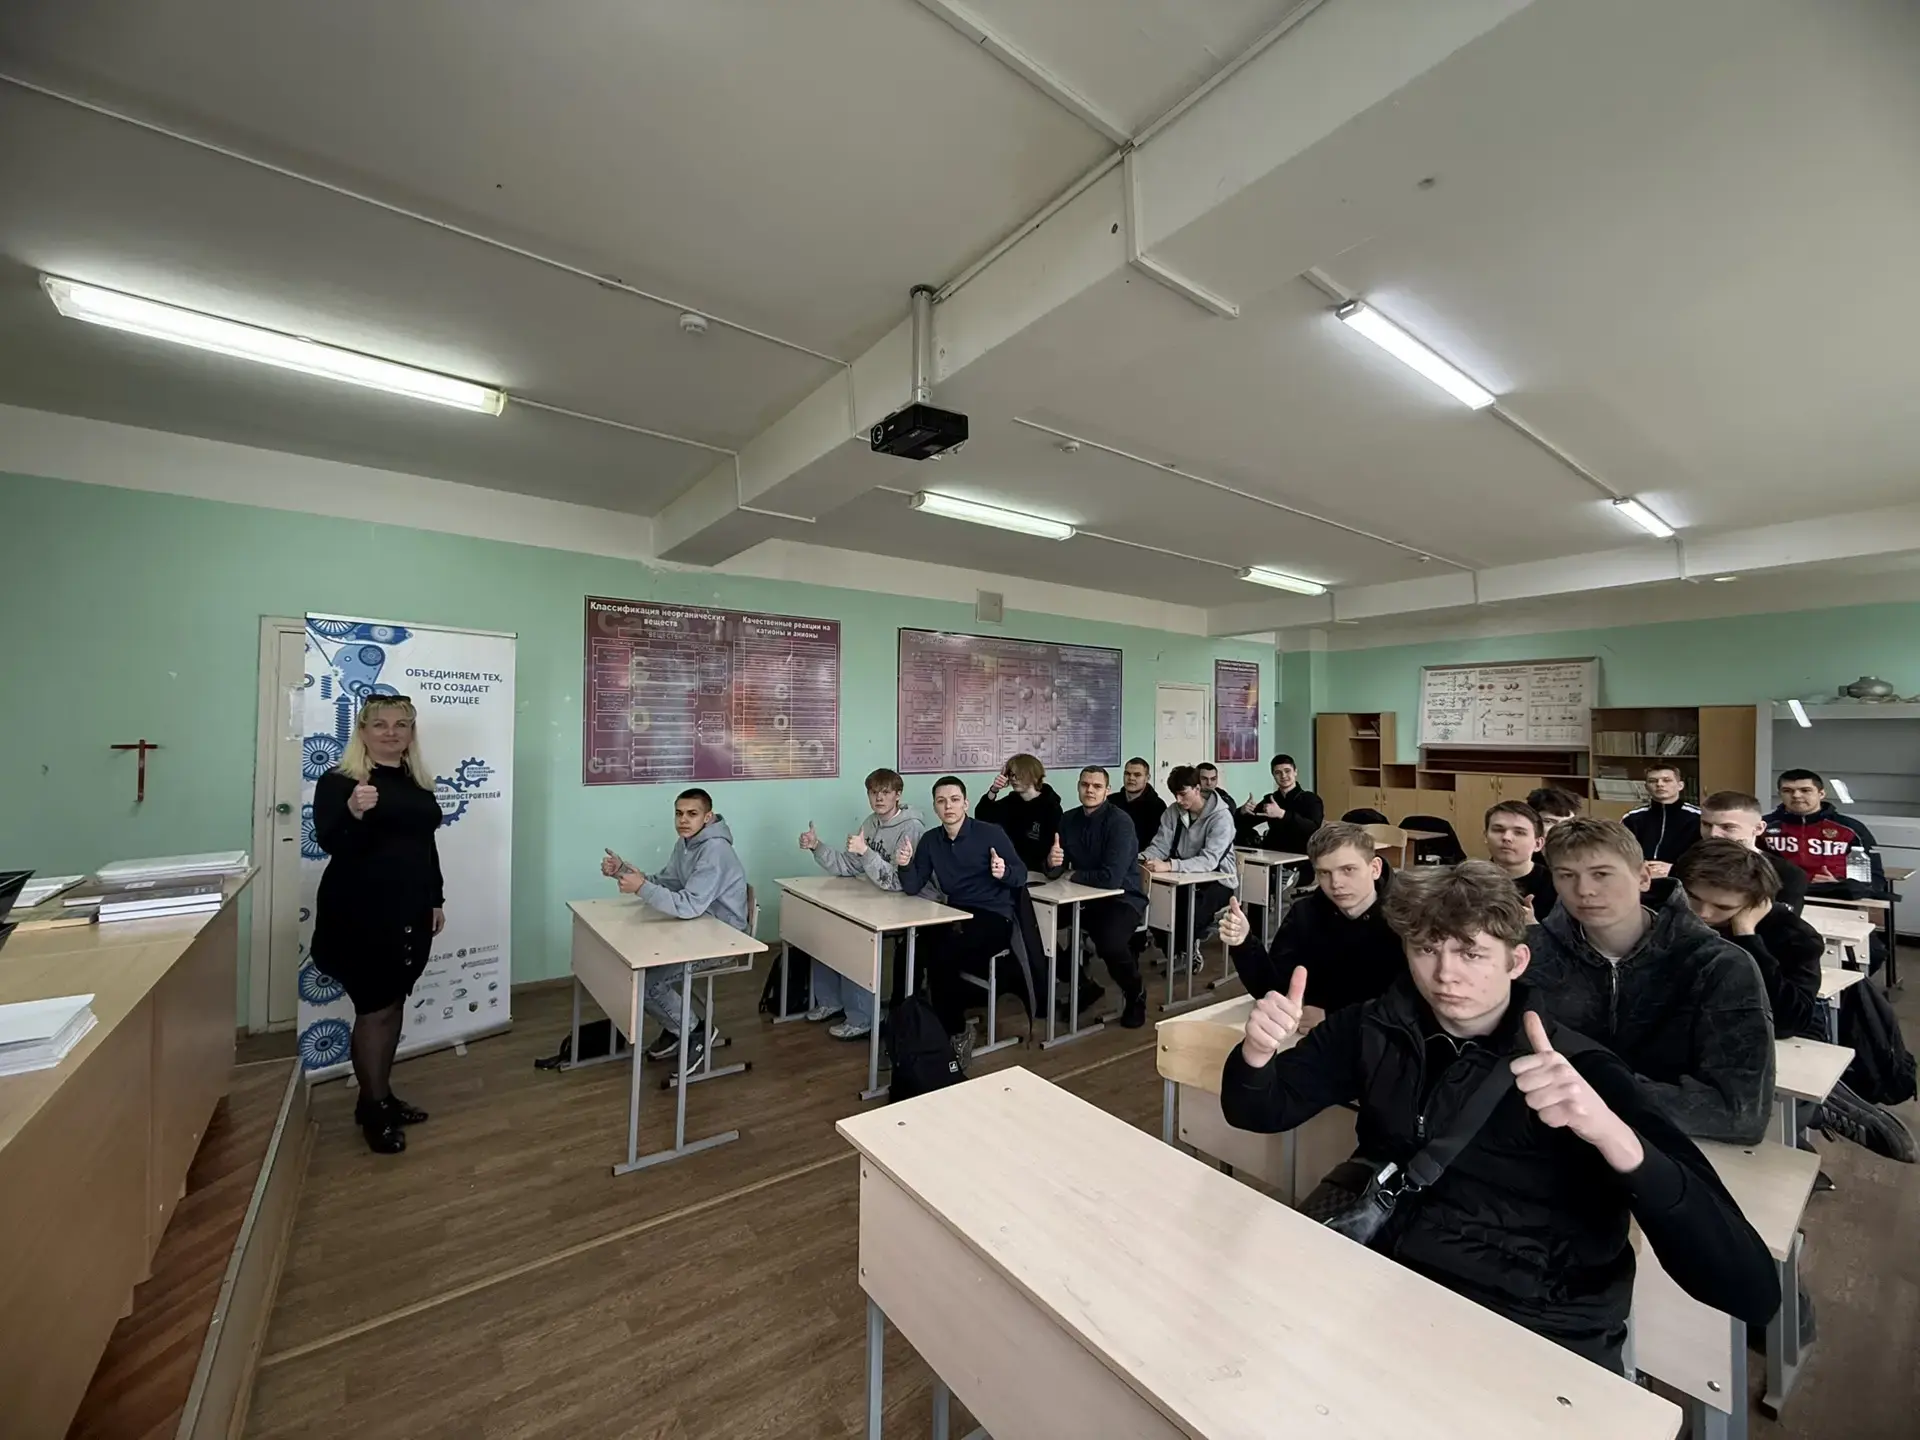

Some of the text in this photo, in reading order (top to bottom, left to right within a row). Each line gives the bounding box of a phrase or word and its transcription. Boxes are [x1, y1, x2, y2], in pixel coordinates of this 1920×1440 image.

[590, 601, 726, 621] Классификация неорганических
[643, 618, 678, 627] веществ
[742, 616, 792, 627] Качественные
[793, 622, 821, 630] реакции
[756, 628, 785, 636] катионы
[793, 631, 819, 639] анионы
[405, 668, 503, 683] ОБЪЕДИНЯЕМ ТЕХ,
[420, 682, 490, 693] КТО СОЗДАЕТ
[430, 695, 480, 705] БУДУЩЕЕ
[436, 791, 501, 801] АШИНОСТРОИТЕЛЕЙ
[1765, 836, 1849, 856] RUS SIA
